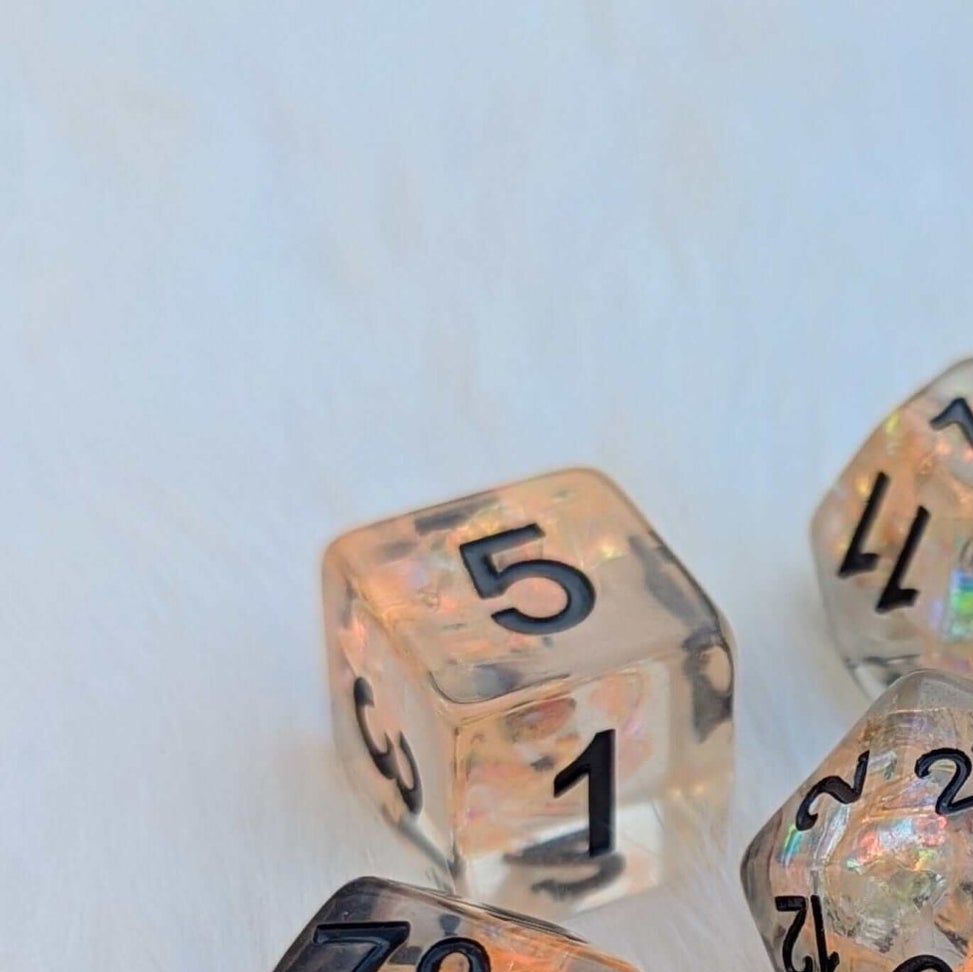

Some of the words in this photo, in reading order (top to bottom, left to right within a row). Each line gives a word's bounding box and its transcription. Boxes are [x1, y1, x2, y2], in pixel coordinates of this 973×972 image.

[460, 523, 596, 635] 5
[553, 728, 616, 857] 1
[795, 750, 870, 831] 2
